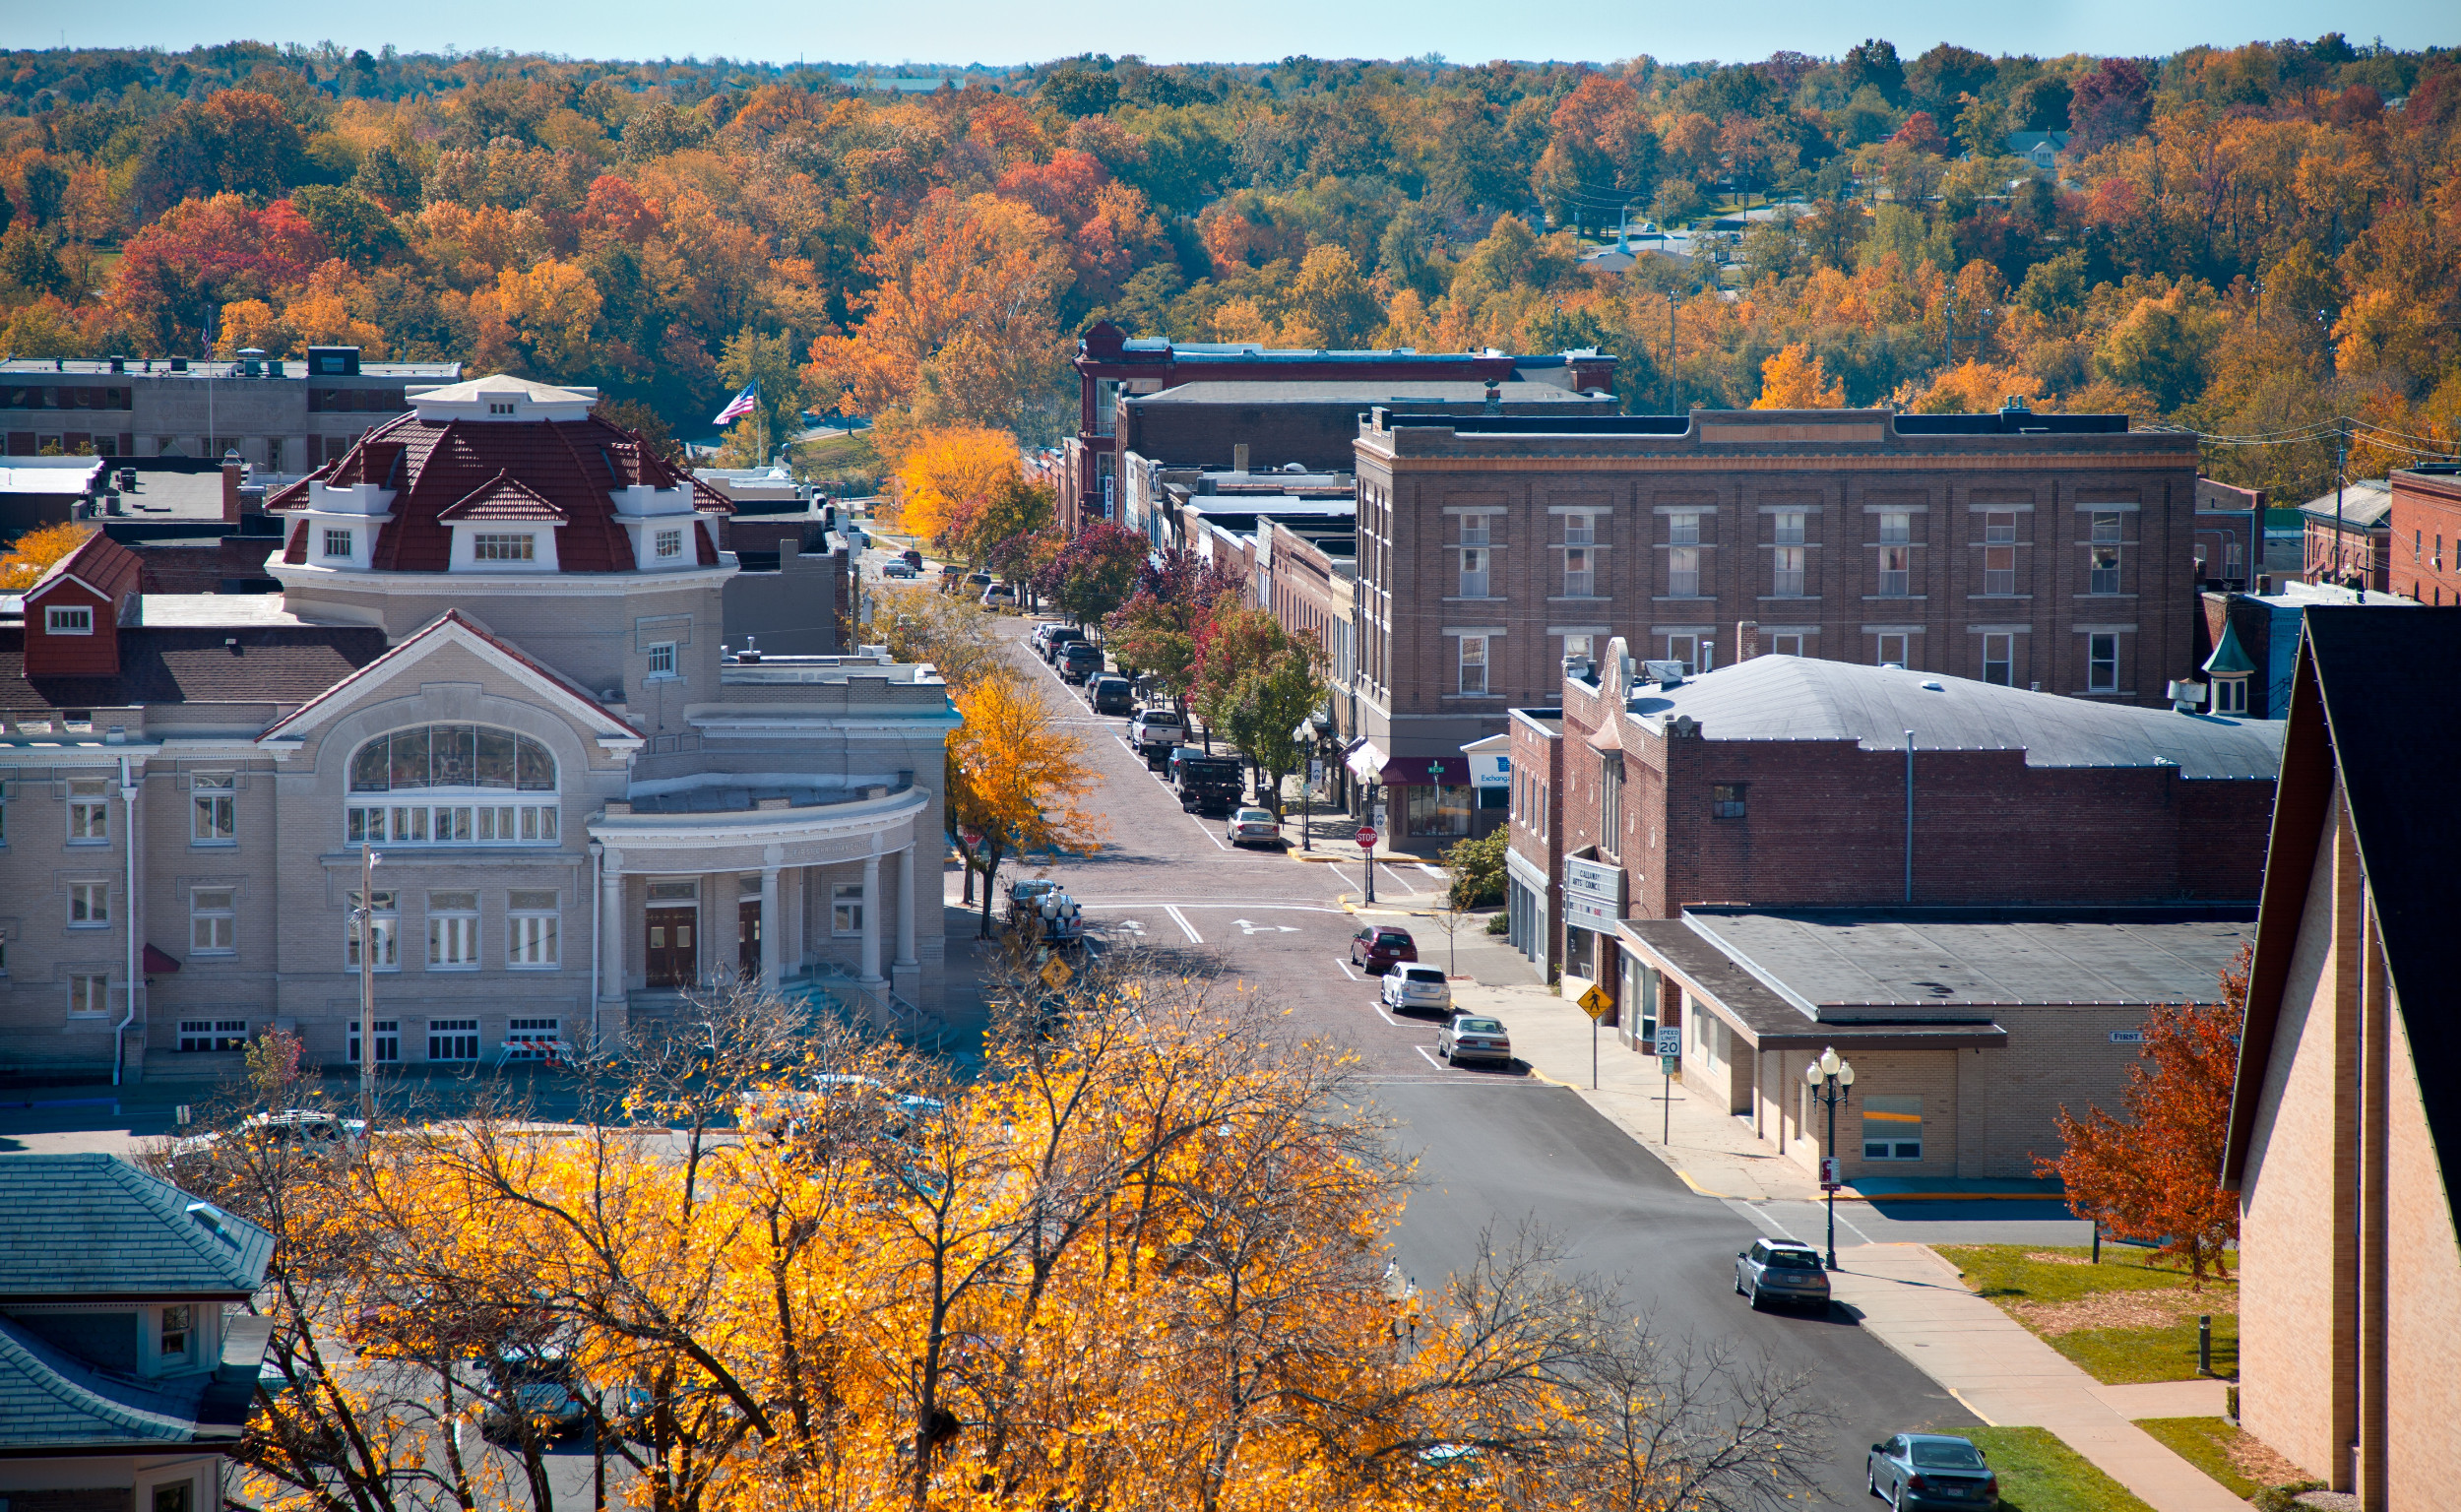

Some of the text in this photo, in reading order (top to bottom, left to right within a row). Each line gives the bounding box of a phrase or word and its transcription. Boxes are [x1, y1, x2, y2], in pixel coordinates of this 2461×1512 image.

[1357, 833, 1376, 842] STOP
[1580, 869, 1600, 881] CALLAWAY
[1585, 880, 1601, 891] COUNCIL
[1659, 1041, 1678, 1053] 20
